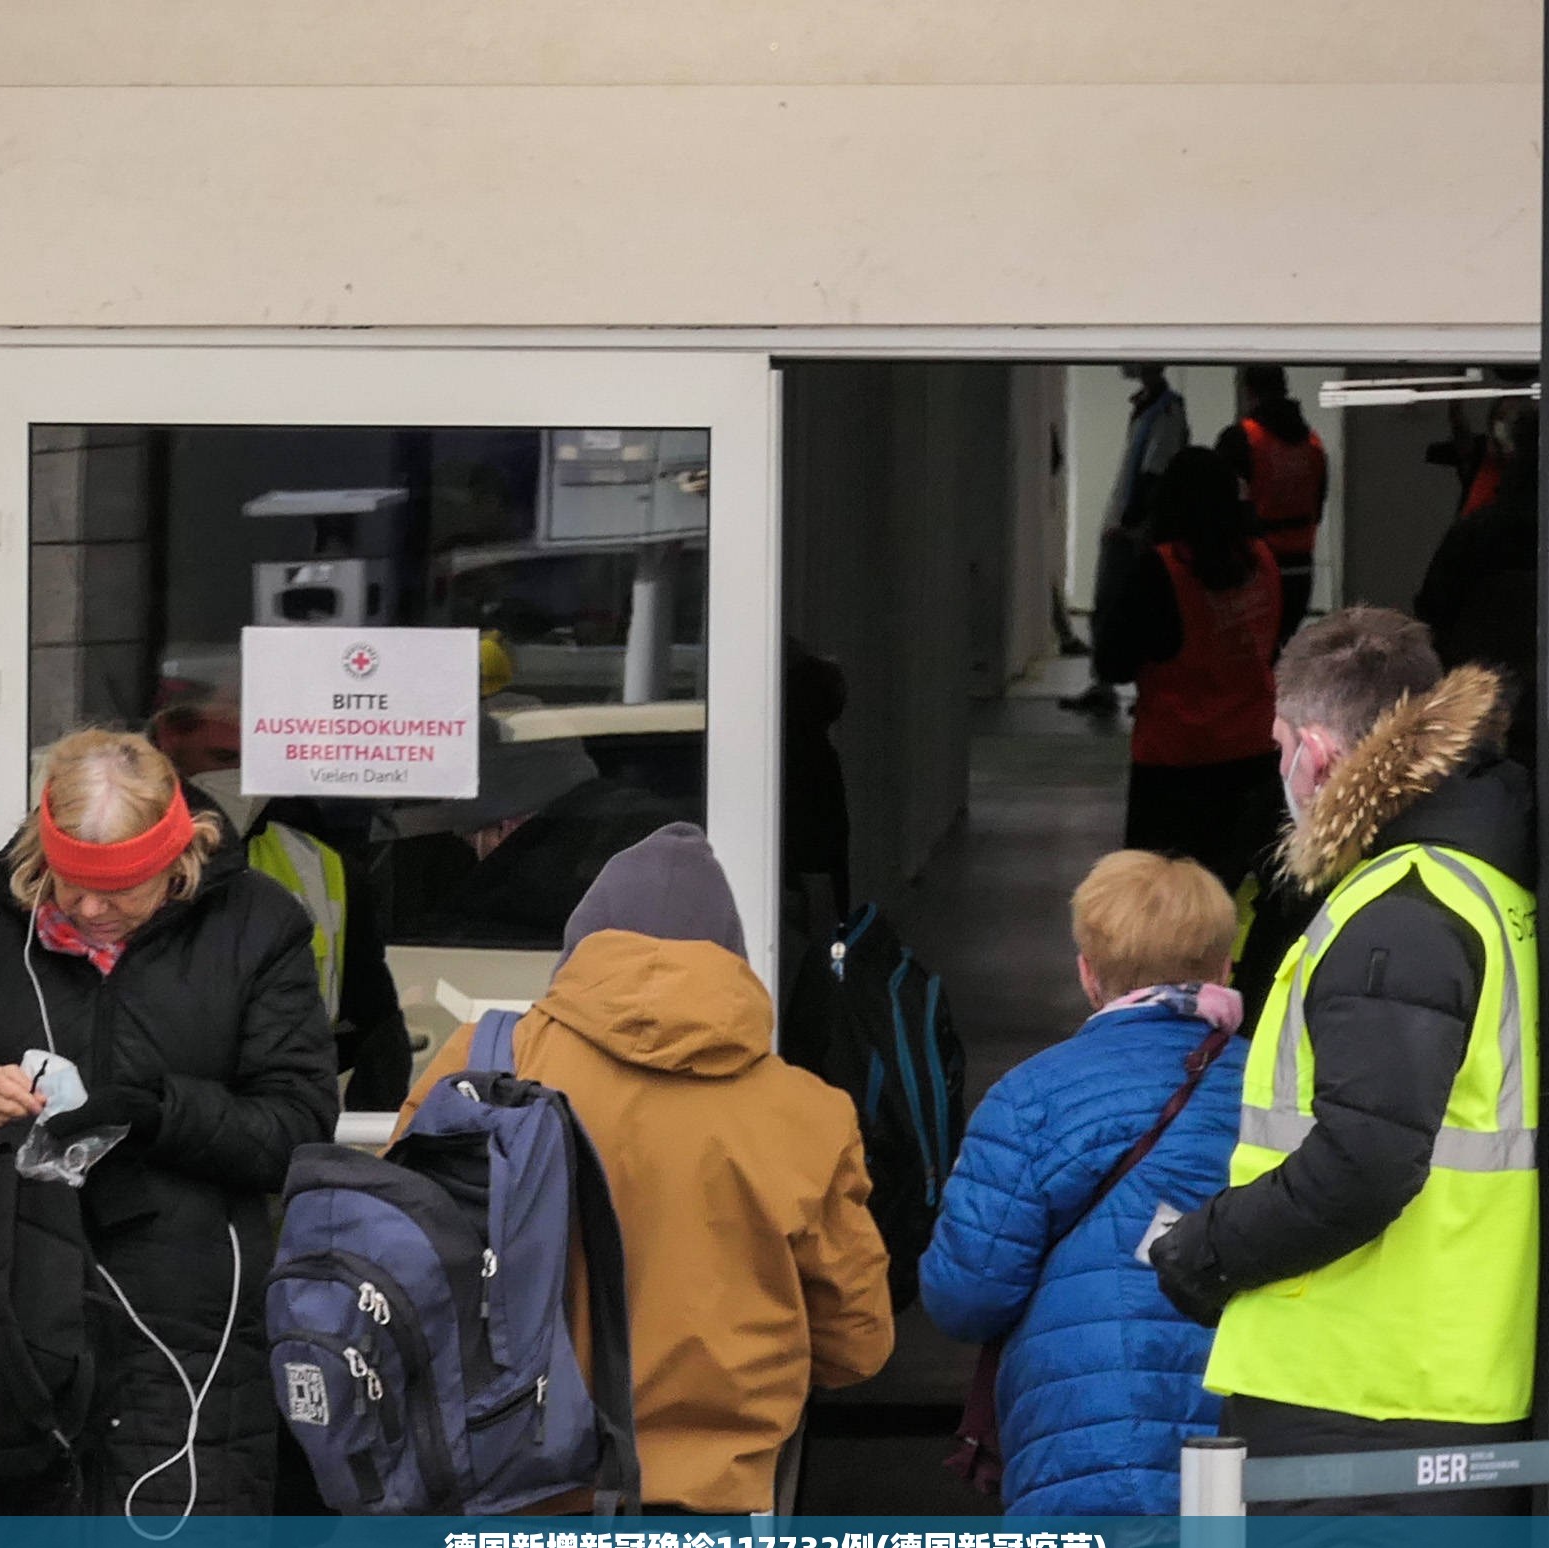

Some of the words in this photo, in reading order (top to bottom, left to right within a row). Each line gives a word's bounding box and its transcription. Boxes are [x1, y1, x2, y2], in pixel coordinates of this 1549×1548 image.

[333, 694, 388, 710] BITTE
[254, 718, 467, 737] AUSWEISDOKUMENT
[285, 744, 435, 762] BEREITHALTEN
[310, 768, 358, 782] Vielen
[364, 769, 408, 783] Dank!
[1417, 1453, 1467, 1485] BER
